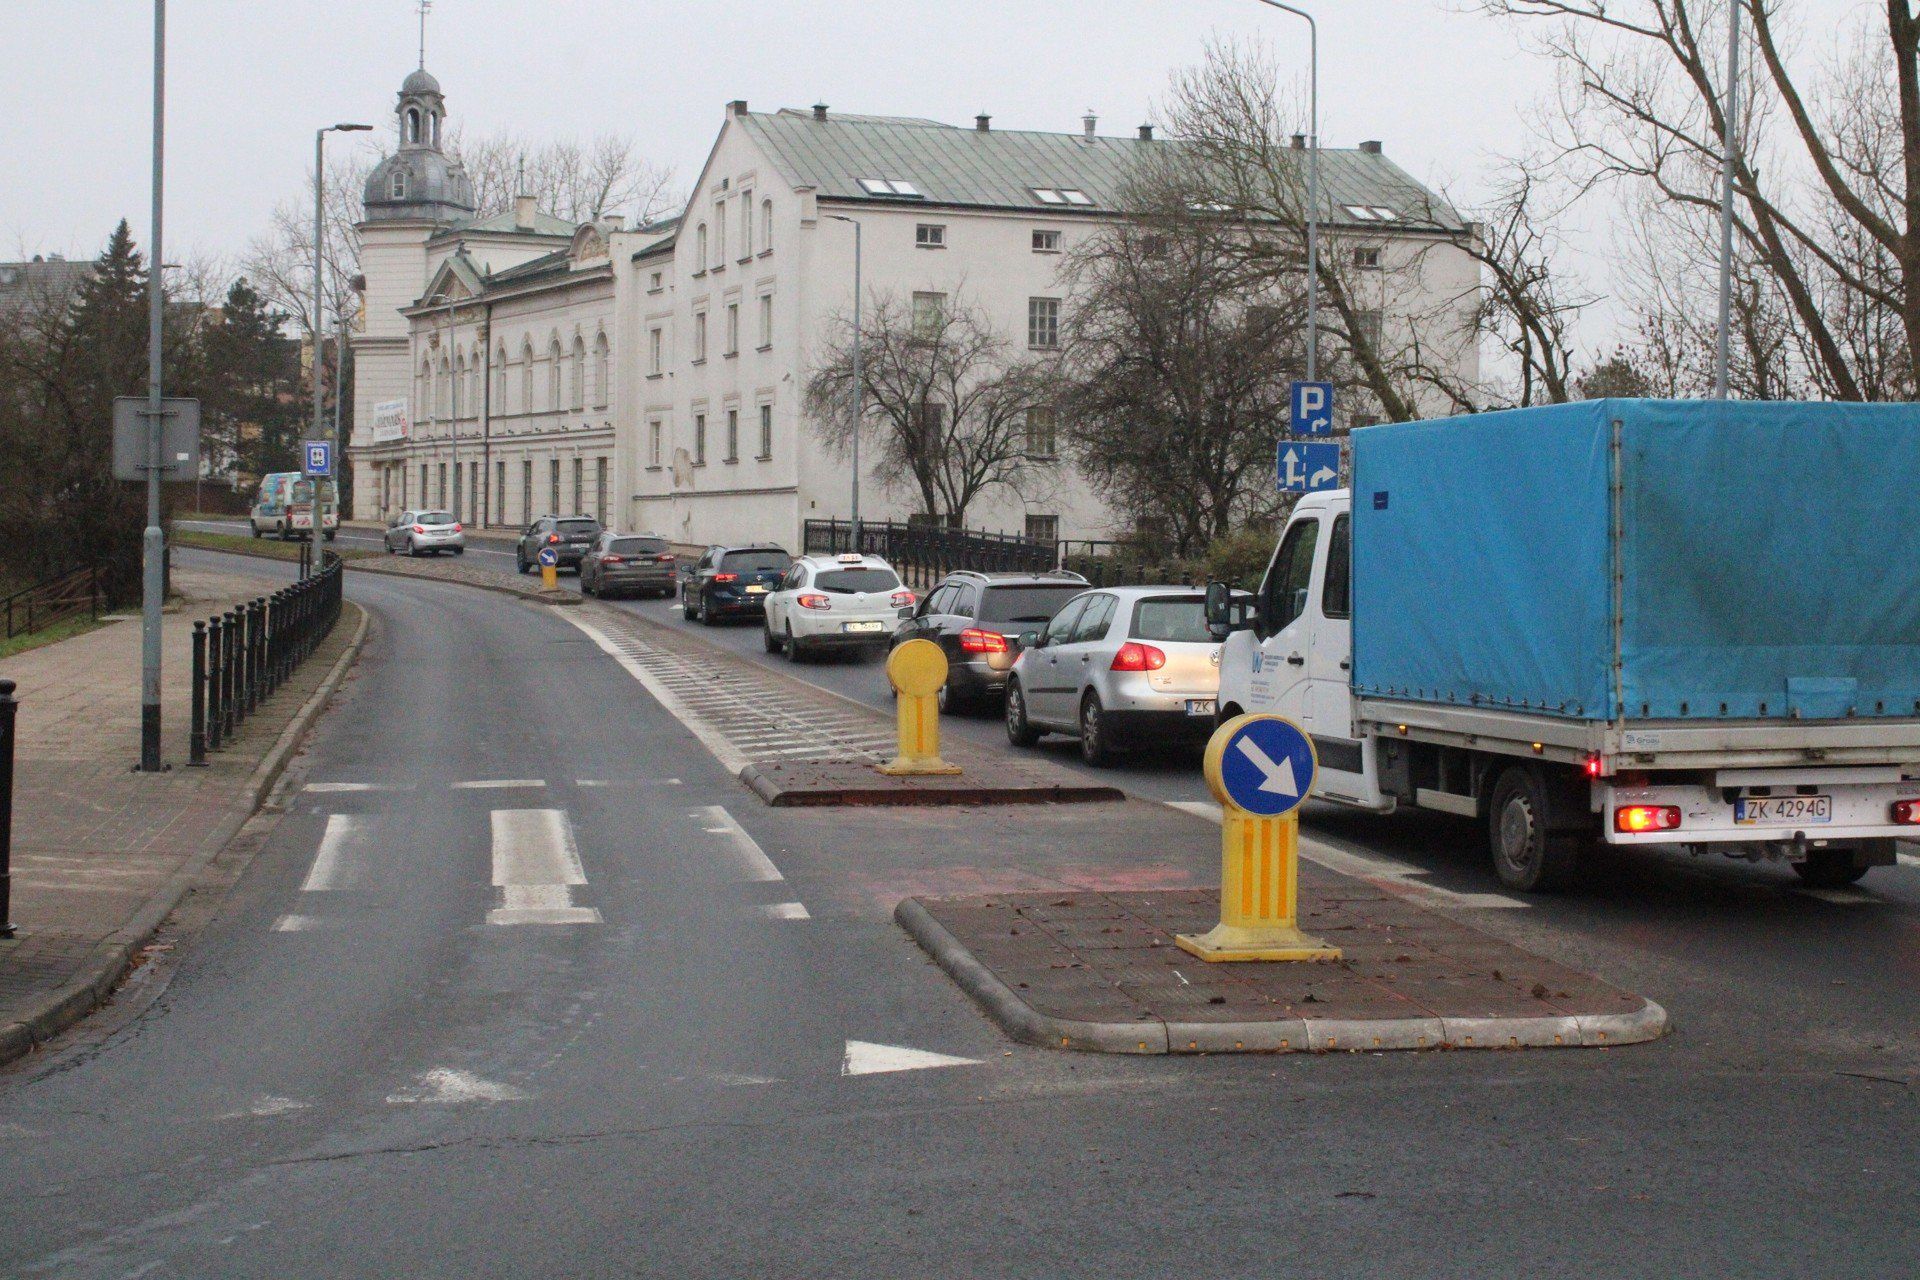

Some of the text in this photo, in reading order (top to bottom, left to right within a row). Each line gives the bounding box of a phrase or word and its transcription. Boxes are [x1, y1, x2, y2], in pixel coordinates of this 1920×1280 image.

[1300, 386, 1325, 419] P
[1194, 701, 1211, 713] ZK
[1748, 799, 1826, 819] ZK 4294G
